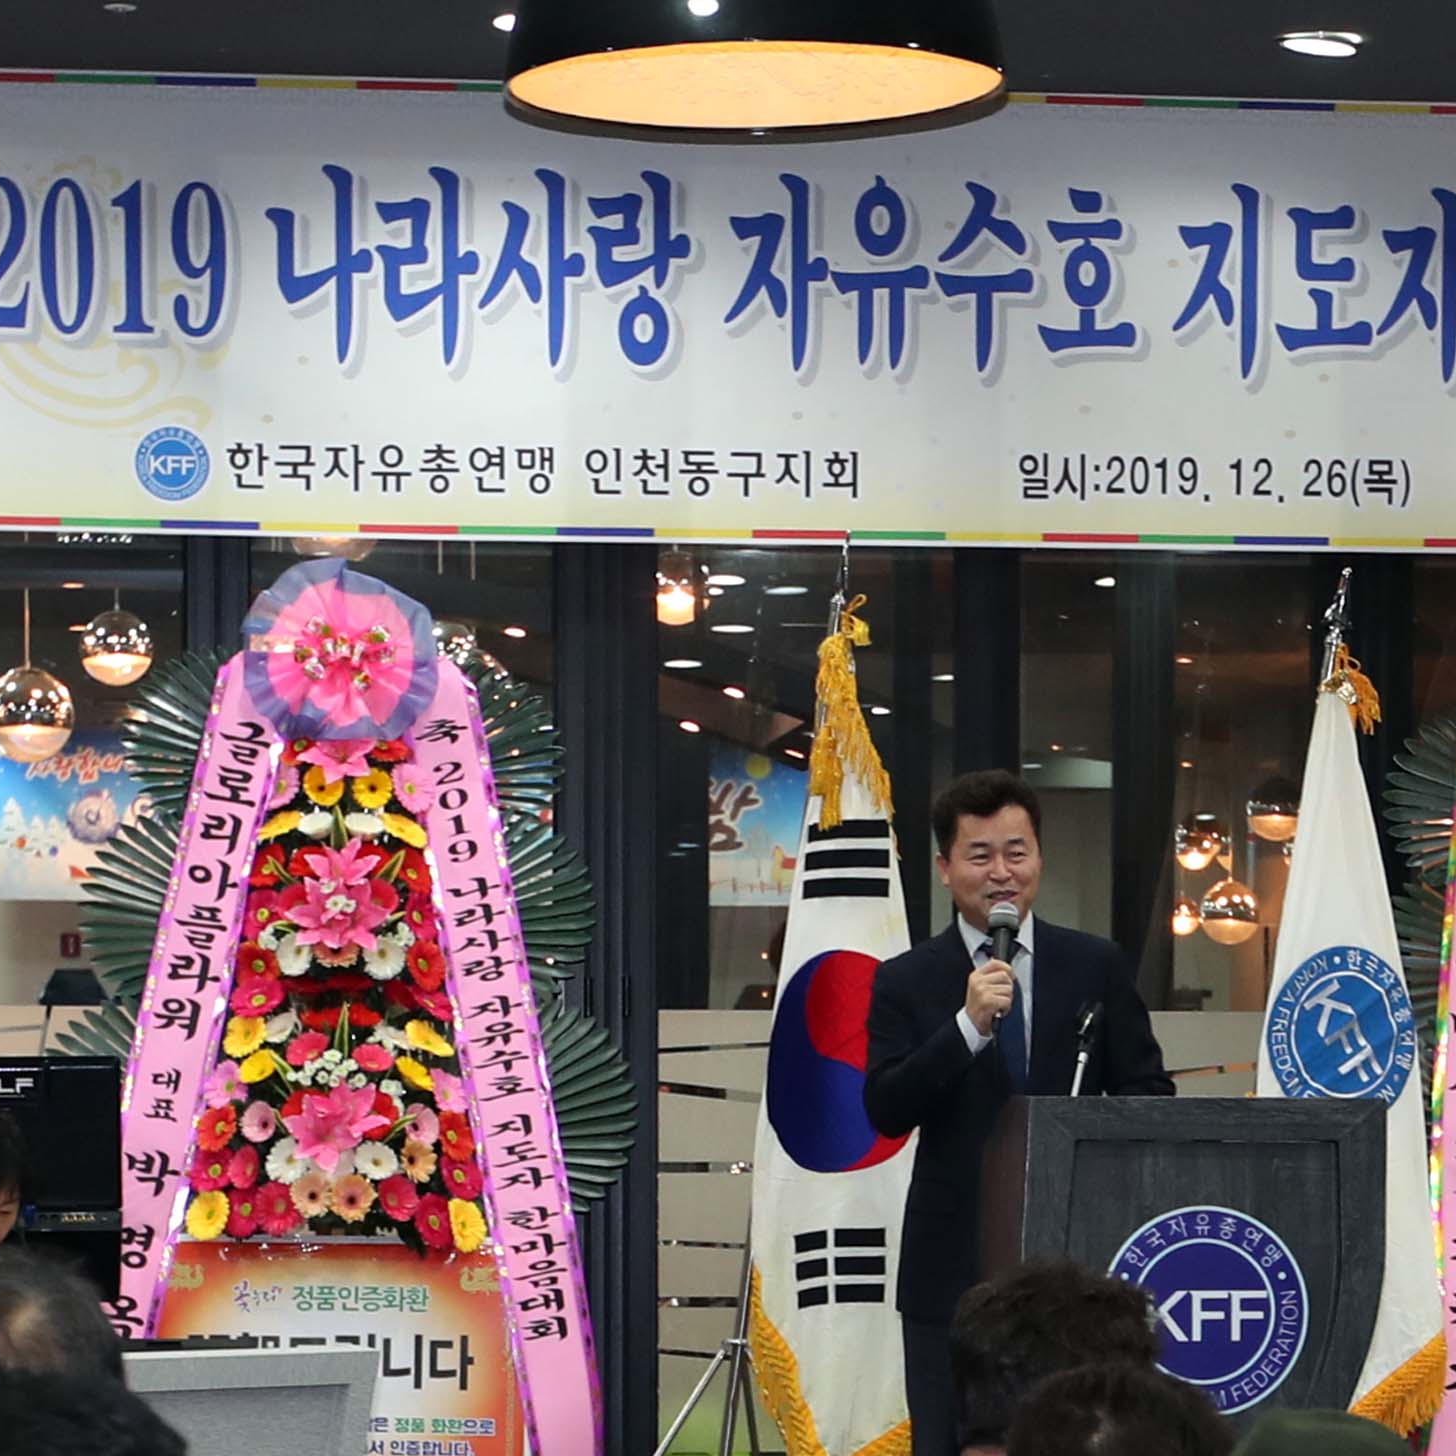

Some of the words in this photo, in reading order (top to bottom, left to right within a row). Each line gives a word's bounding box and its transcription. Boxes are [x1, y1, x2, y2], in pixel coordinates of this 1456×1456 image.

[265, 164, 691, 366] 나라사랑
[722, 172, 1138, 371] 자유수호
[149, 454, 196, 476] KFF
[226, 441, 555, 495] 한국자유총연맹
[584, 448, 860, 500] 인천동구지회
[1018, 453, 1215, 504] 일시:2019.
[1227, 458, 1285, 504] 12.
[1301, 458, 1412, 508] 26(목)
[415, 718, 469, 745] 축
[432, 761, 479, 863] 2019
[152, 721, 271, 1040] 글로리아플라워
[446, 877, 516, 983] 나라사랑
[465, 994, 536, 1102] 자유수호
[145, 1068, 182, 1122] 대표
[489, 1113, 556, 1190] 지도자
[505, 1206, 569, 1342] 한마음대회
[1123, 1213, 1283, 1269] 한국자유총연맹
[291, 1285, 430, 1314] 정품인증화환
[1229, 1288, 1299, 1403] FEDERATION
